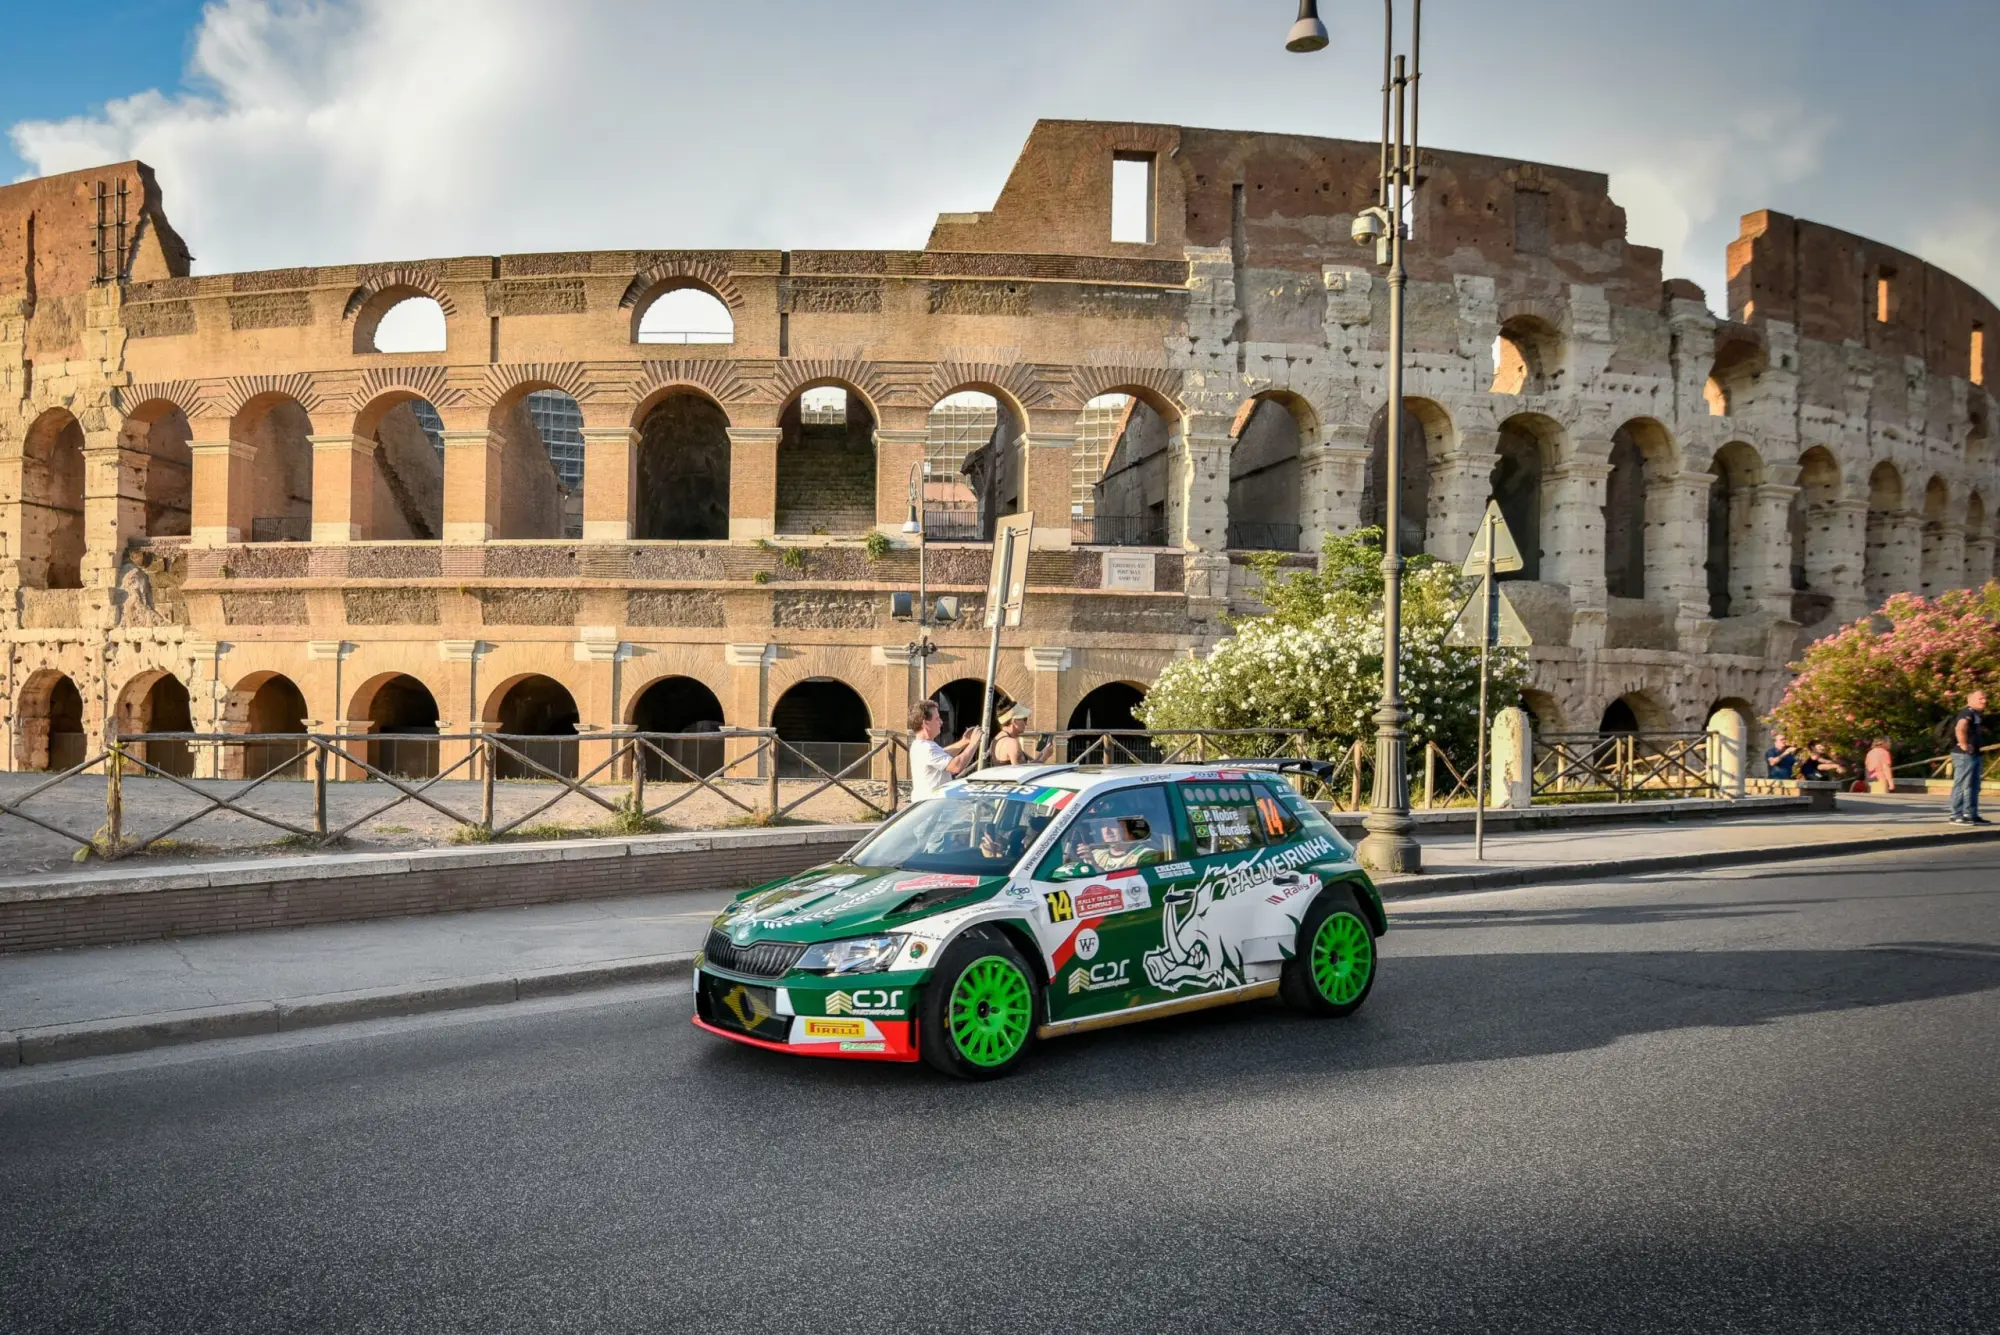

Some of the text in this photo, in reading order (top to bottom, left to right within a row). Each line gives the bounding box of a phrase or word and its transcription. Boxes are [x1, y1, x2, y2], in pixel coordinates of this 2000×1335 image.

[958, 784, 1039, 796] SEAJETS
[1203, 809, 1240, 821] P. Nobre
[1256, 797, 1285, 836] 14
[1208, 824, 1251, 837] G. Morales
[1225, 835, 1336, 897] PALMEIRINHA
[1283, 883, 1310, 899] Rally
[1047, 890, 1073, 922] 14
[809, 1022, 860, 1035] PIRELLI
